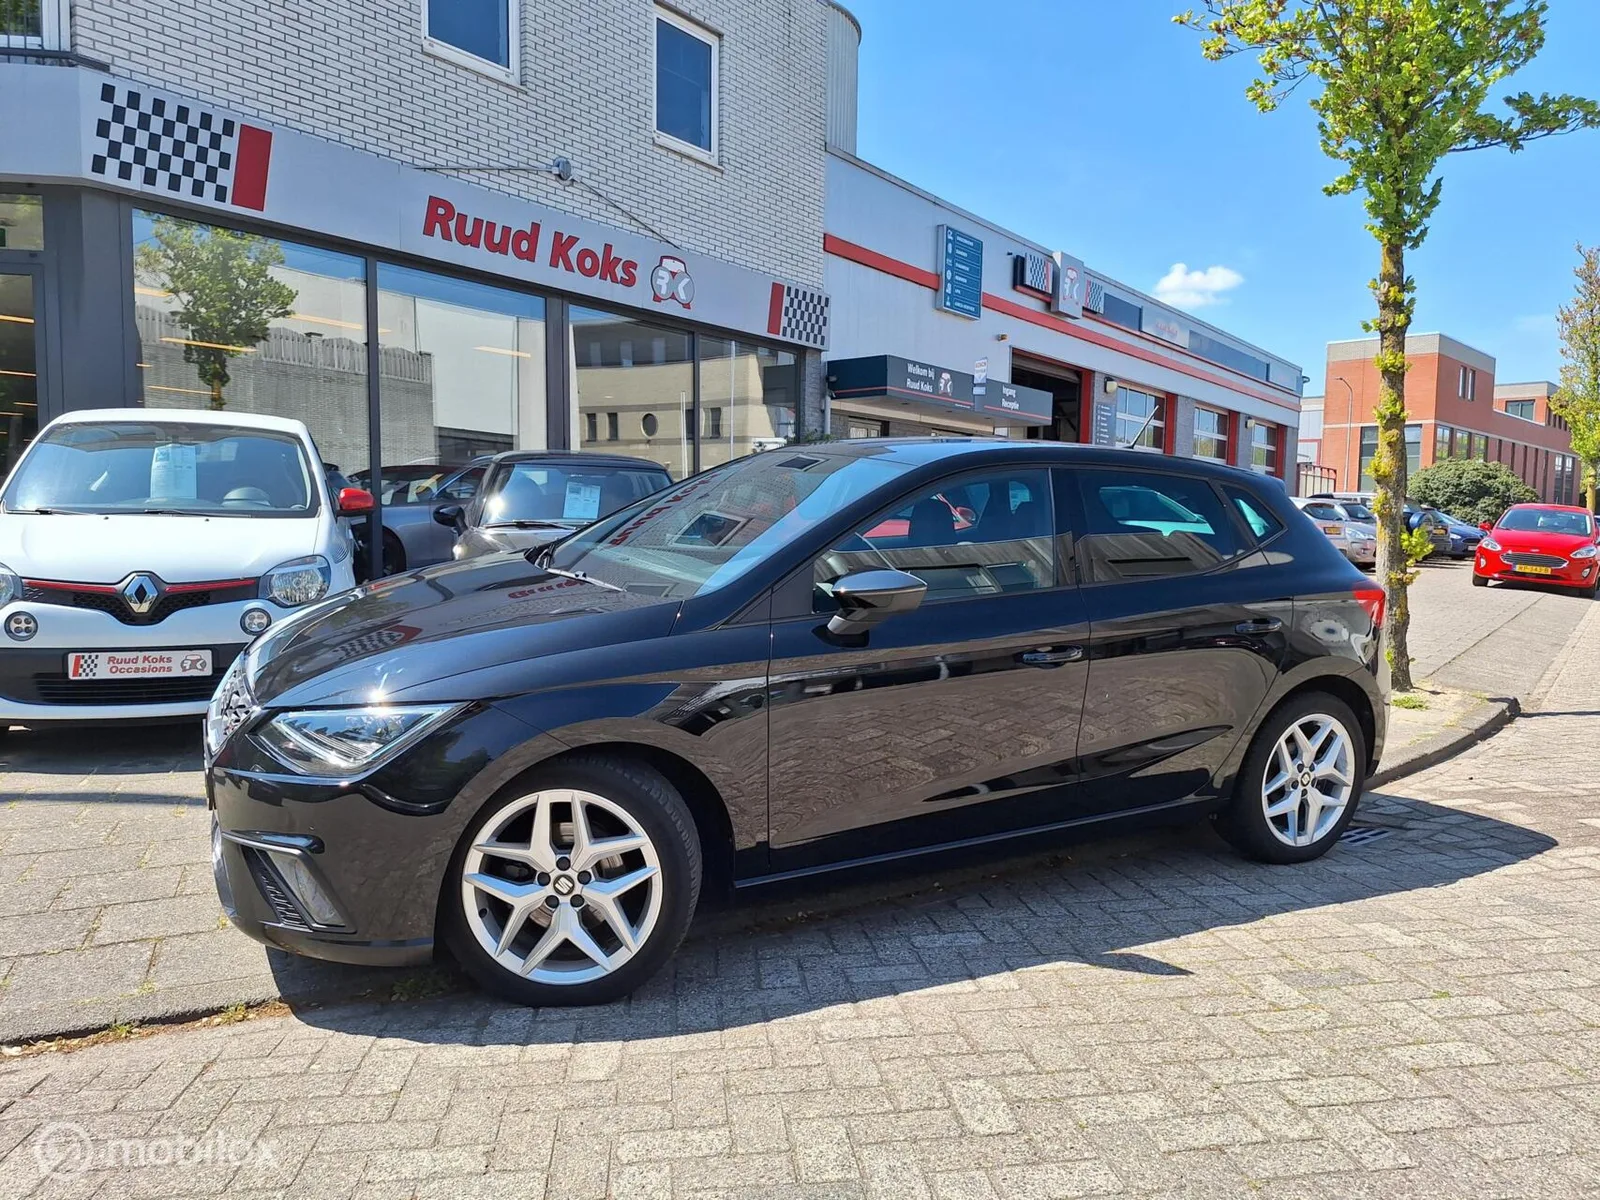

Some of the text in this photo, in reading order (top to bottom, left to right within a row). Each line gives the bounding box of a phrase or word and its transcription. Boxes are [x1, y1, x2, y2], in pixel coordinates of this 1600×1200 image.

[422, 195, 638, 288] Ruud Koks
[907, 363, 928, 377] Welkom
[906, 378, 933, 393] Ruud Koks
[1002, 385, 1016, 398] Ingang
[1001, 398, 1019, 411] Receptie
[107, 655, 173, 665] Ruud Koks
[109, 664, 173, 674] Occasions
